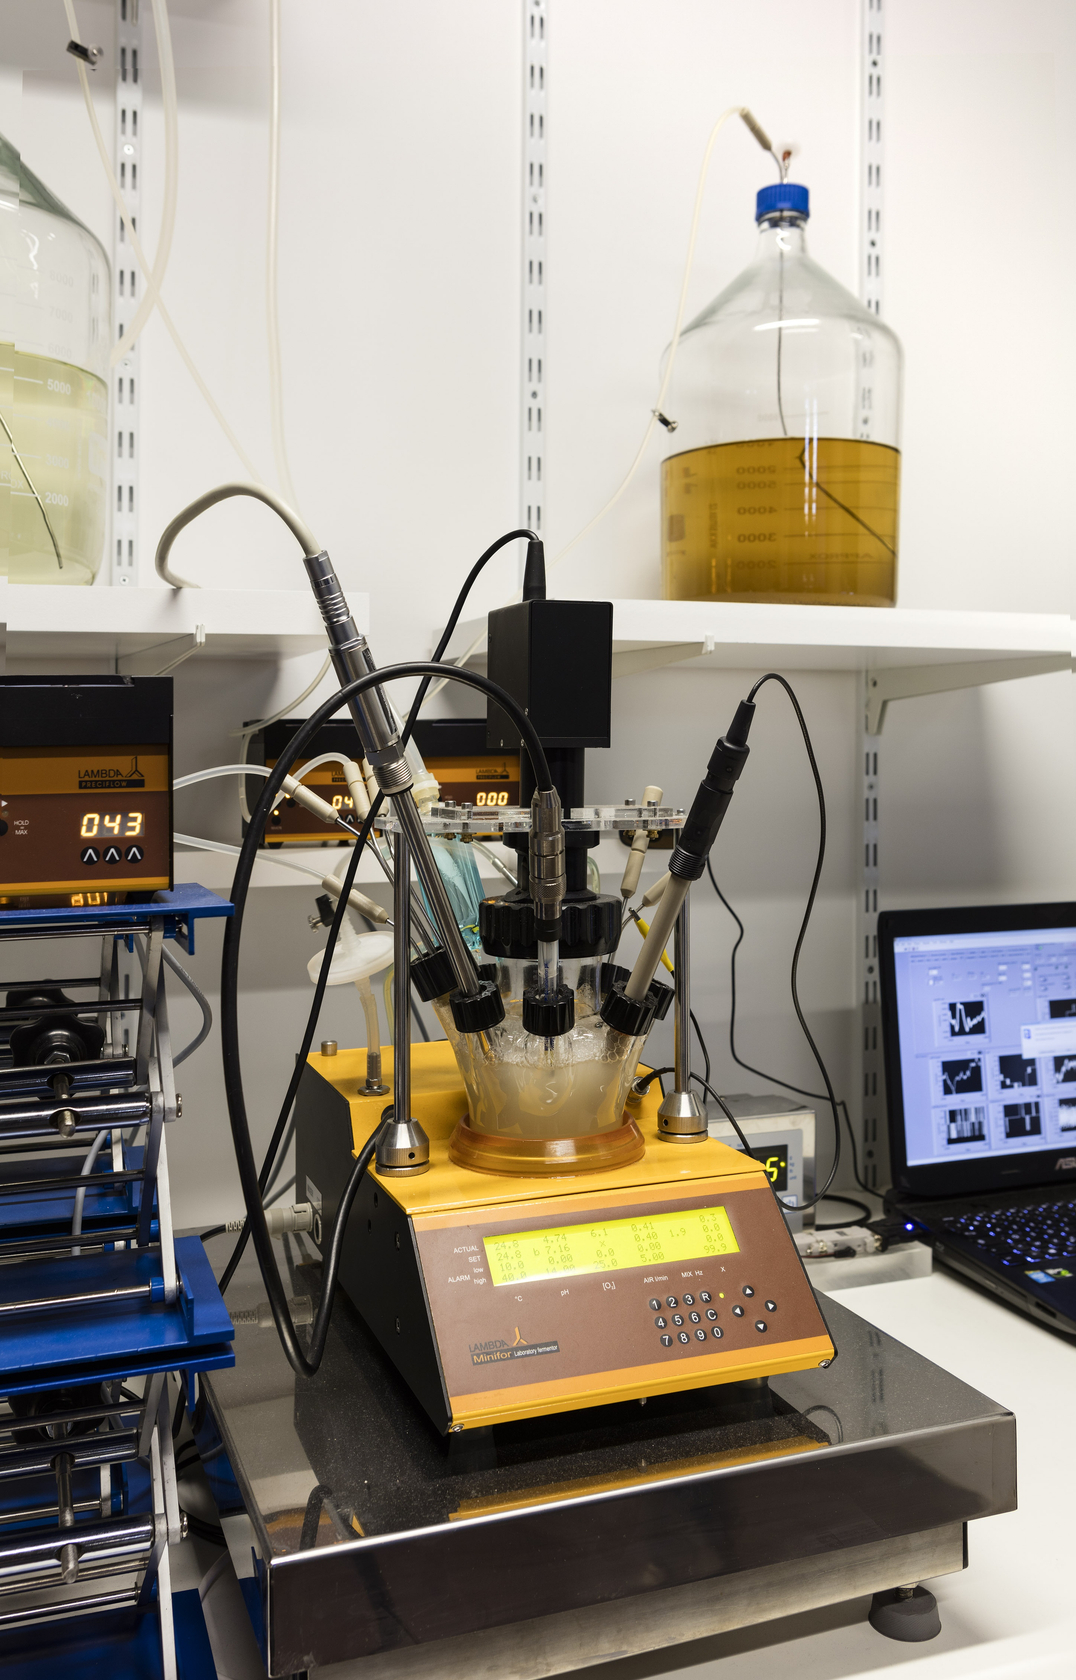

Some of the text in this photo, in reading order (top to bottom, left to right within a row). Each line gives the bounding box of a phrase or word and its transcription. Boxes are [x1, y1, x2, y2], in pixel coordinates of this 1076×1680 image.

[47, 378, 71, 396] 5000
[45, 453, 70, 469] 3000
[44, 491, 69, 507] 2000
[78, 769, 124, 779] LAMBDA
[81, 780, 128, 788] PRECIFLOW
[476, 792, 509, 806] 000
[80, 812, 143, 837] 043
[494, 1213, 717, 1251] 24.8 4.74 6.1 0.41 0.3
[453, 1245, 479, 1254] ACTUAL
[496, 1250, 522, 1261] 24.8
[545, 1243, 570, 1255] 7.16
[634, 1231, 658, 1243] 0.40
[669, 1227, 687, 1238] 1.9
[702, 1223, 720, 1233] 0.0
[468, 1255, 481, 1263] SET
[500, 1233, 724, 1272] 10.0 0.00 0.0 0.00 0.0
[640, 1251, 665, 1263] 5.00
[703, 1243, 727, 1253] 99.9
[448, 1274, 471, 1283] ALARM
[473, 1277, 487, 1285] high
[643, 1276, 654, 1284] AIR
[560, 1289, 570, 1297] pH
[652, 1292, 711, 1310] 1 2 3 R
[658, 1309, 716, 1328] 4 5 6 C
[468, 1339, 509, 1352] LAMBDA
[662, 1335, 669, 1346] 7
[680, 1332, 688, 1343] 8
[697, 1330, 705, 1340] 9
[473, 1344, 558, 1363] Minifor Laboratory fermentor
